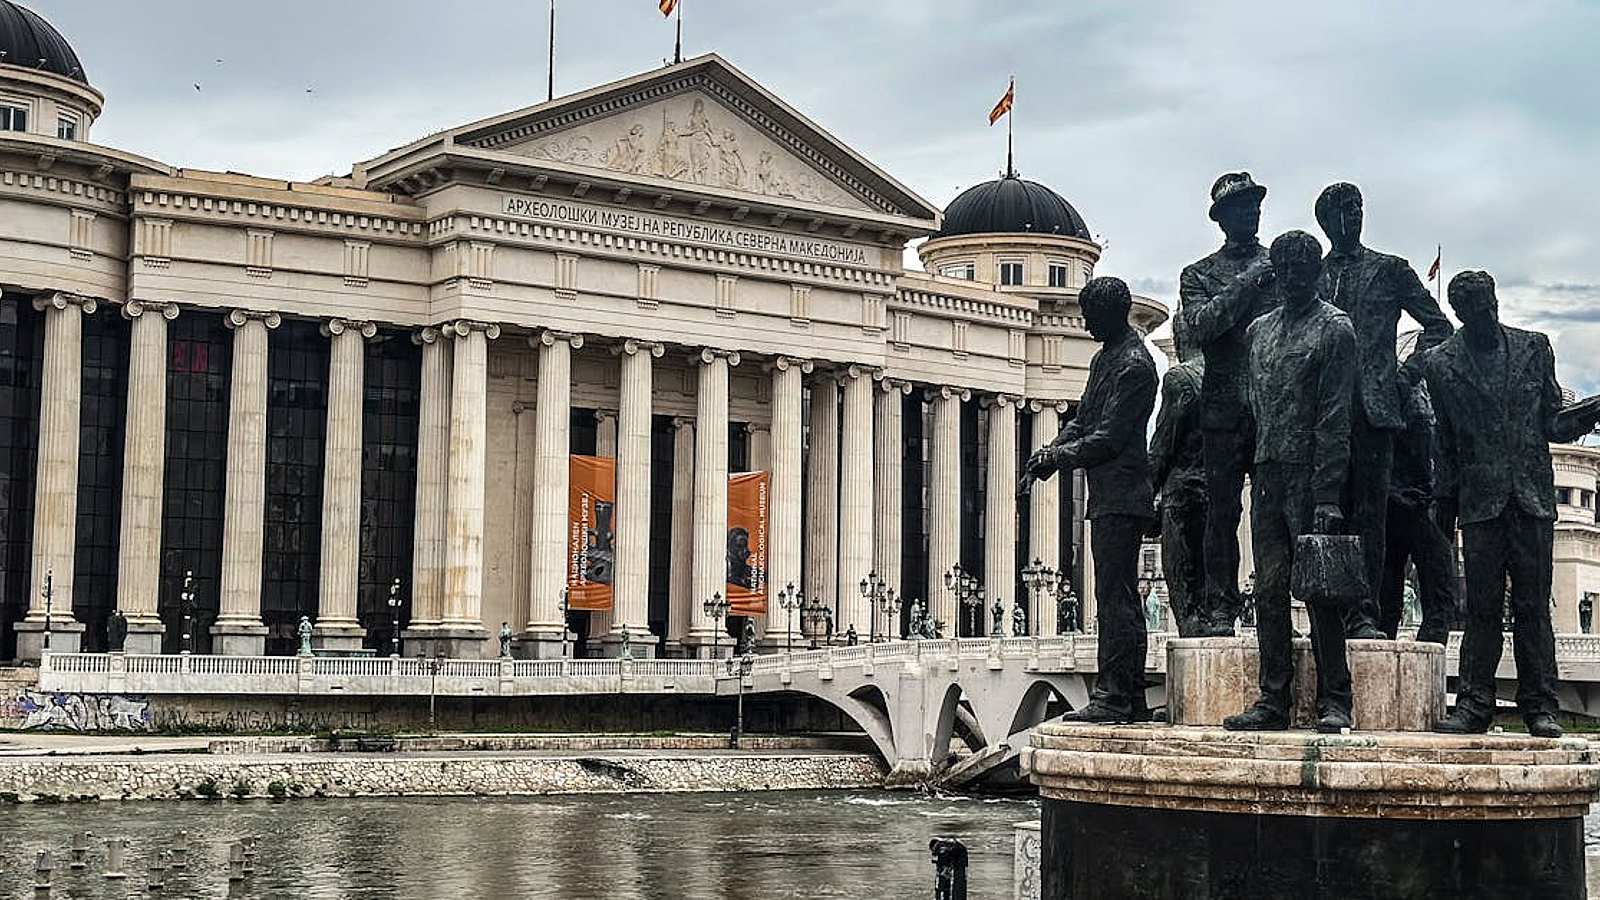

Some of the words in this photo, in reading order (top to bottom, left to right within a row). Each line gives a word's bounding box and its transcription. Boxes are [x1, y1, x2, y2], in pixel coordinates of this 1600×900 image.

[507, 198, 598, 225] АРХЕОЛОШКИ
[602, 211, 640, 231] МУЗЕЈ
[643, 218, 660, 234] НА
[663, 221, 733, 245] РЕПУБЛИКА
[735, 232, 787, 252] СЕВЕРНА
[789, 239, 866, 264] МАКЕДОНИЈА
[758, 481, 767, 518] MUSEUM
[750, 552, 758, 595] NATIONAL
[757, 519, 766, 595] ARCHAEOLOGICAL
